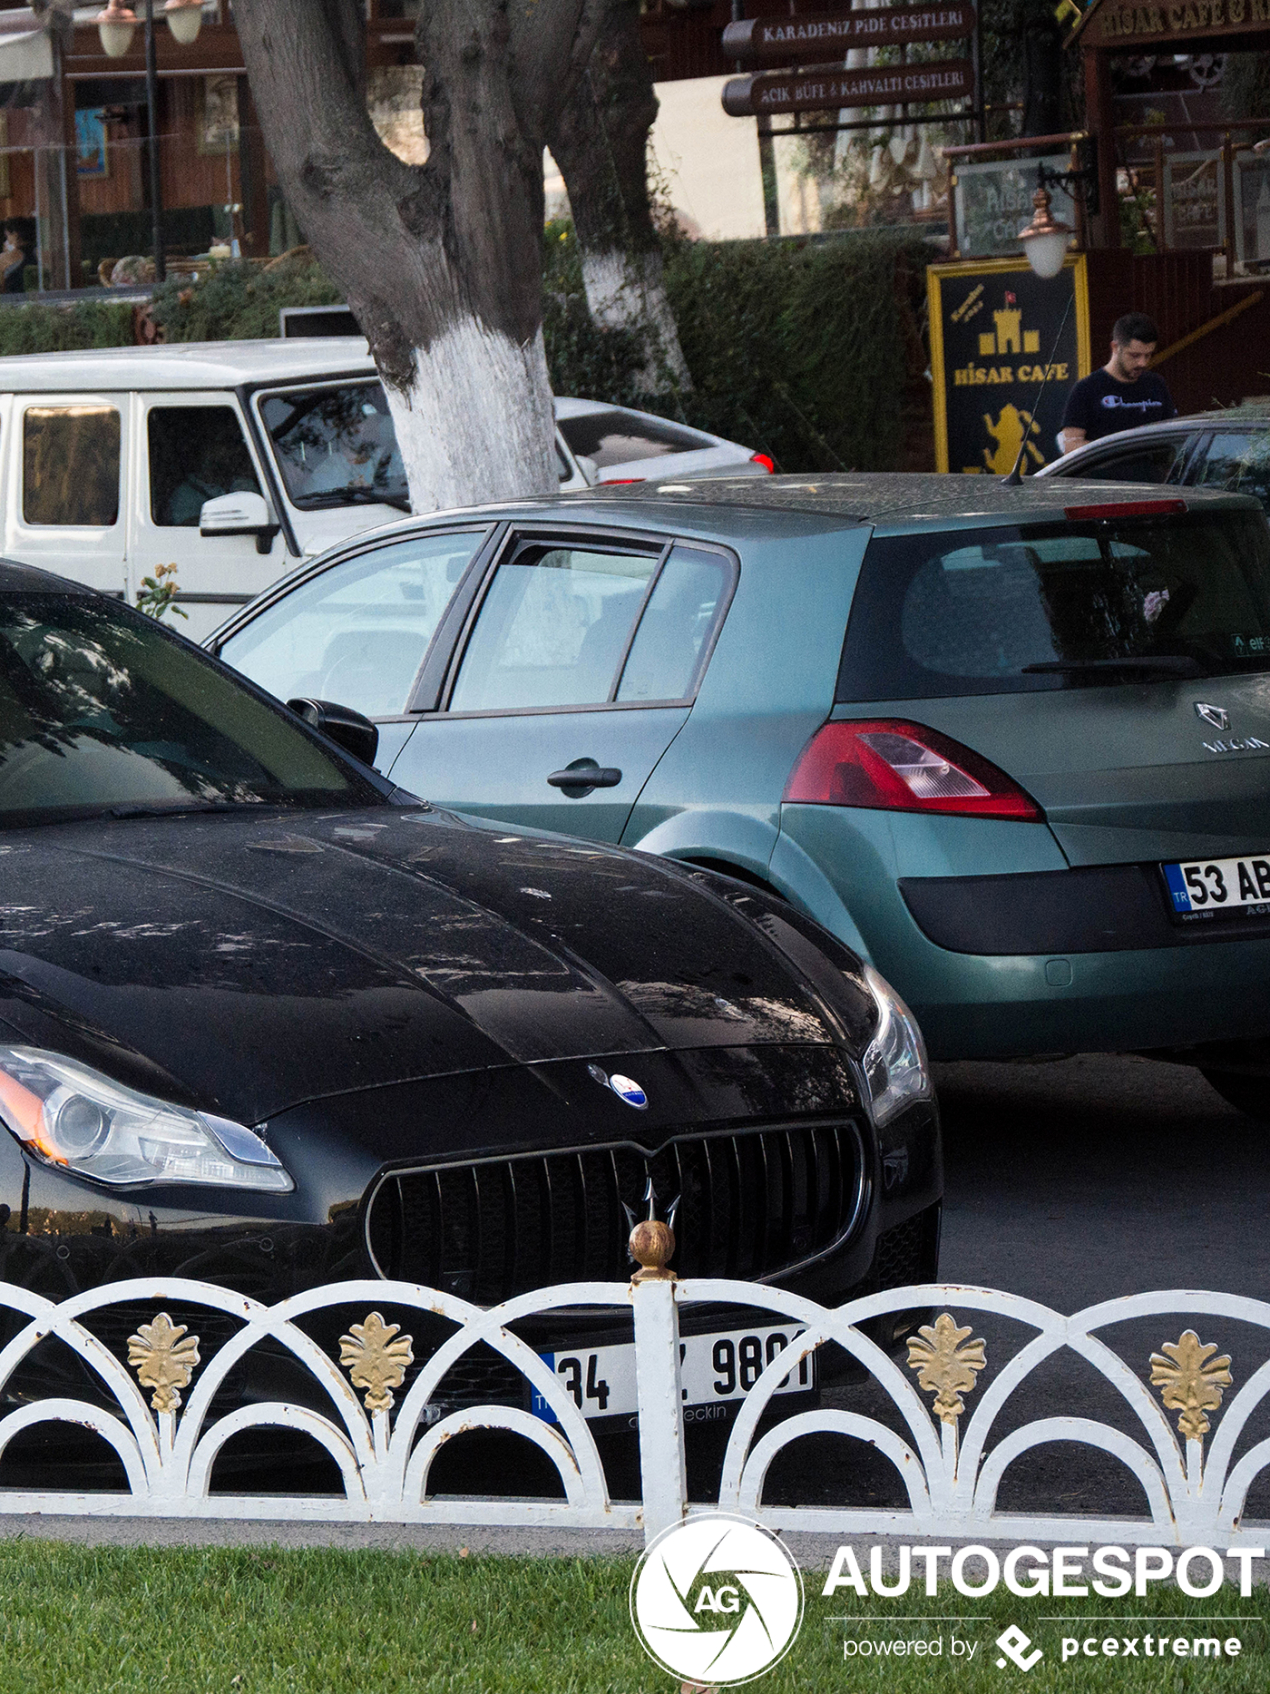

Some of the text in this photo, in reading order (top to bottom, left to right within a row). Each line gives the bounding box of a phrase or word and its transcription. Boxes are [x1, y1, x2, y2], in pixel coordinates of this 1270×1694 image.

[1017, 363, 1069, 382] CAFE
[1184, 860, 1270, 904] 53 AB
[1173, 891, 1189, 903] TR
[558, 1354, 610, 1410] 34
[683, 1405, 726, 1422] eckin
